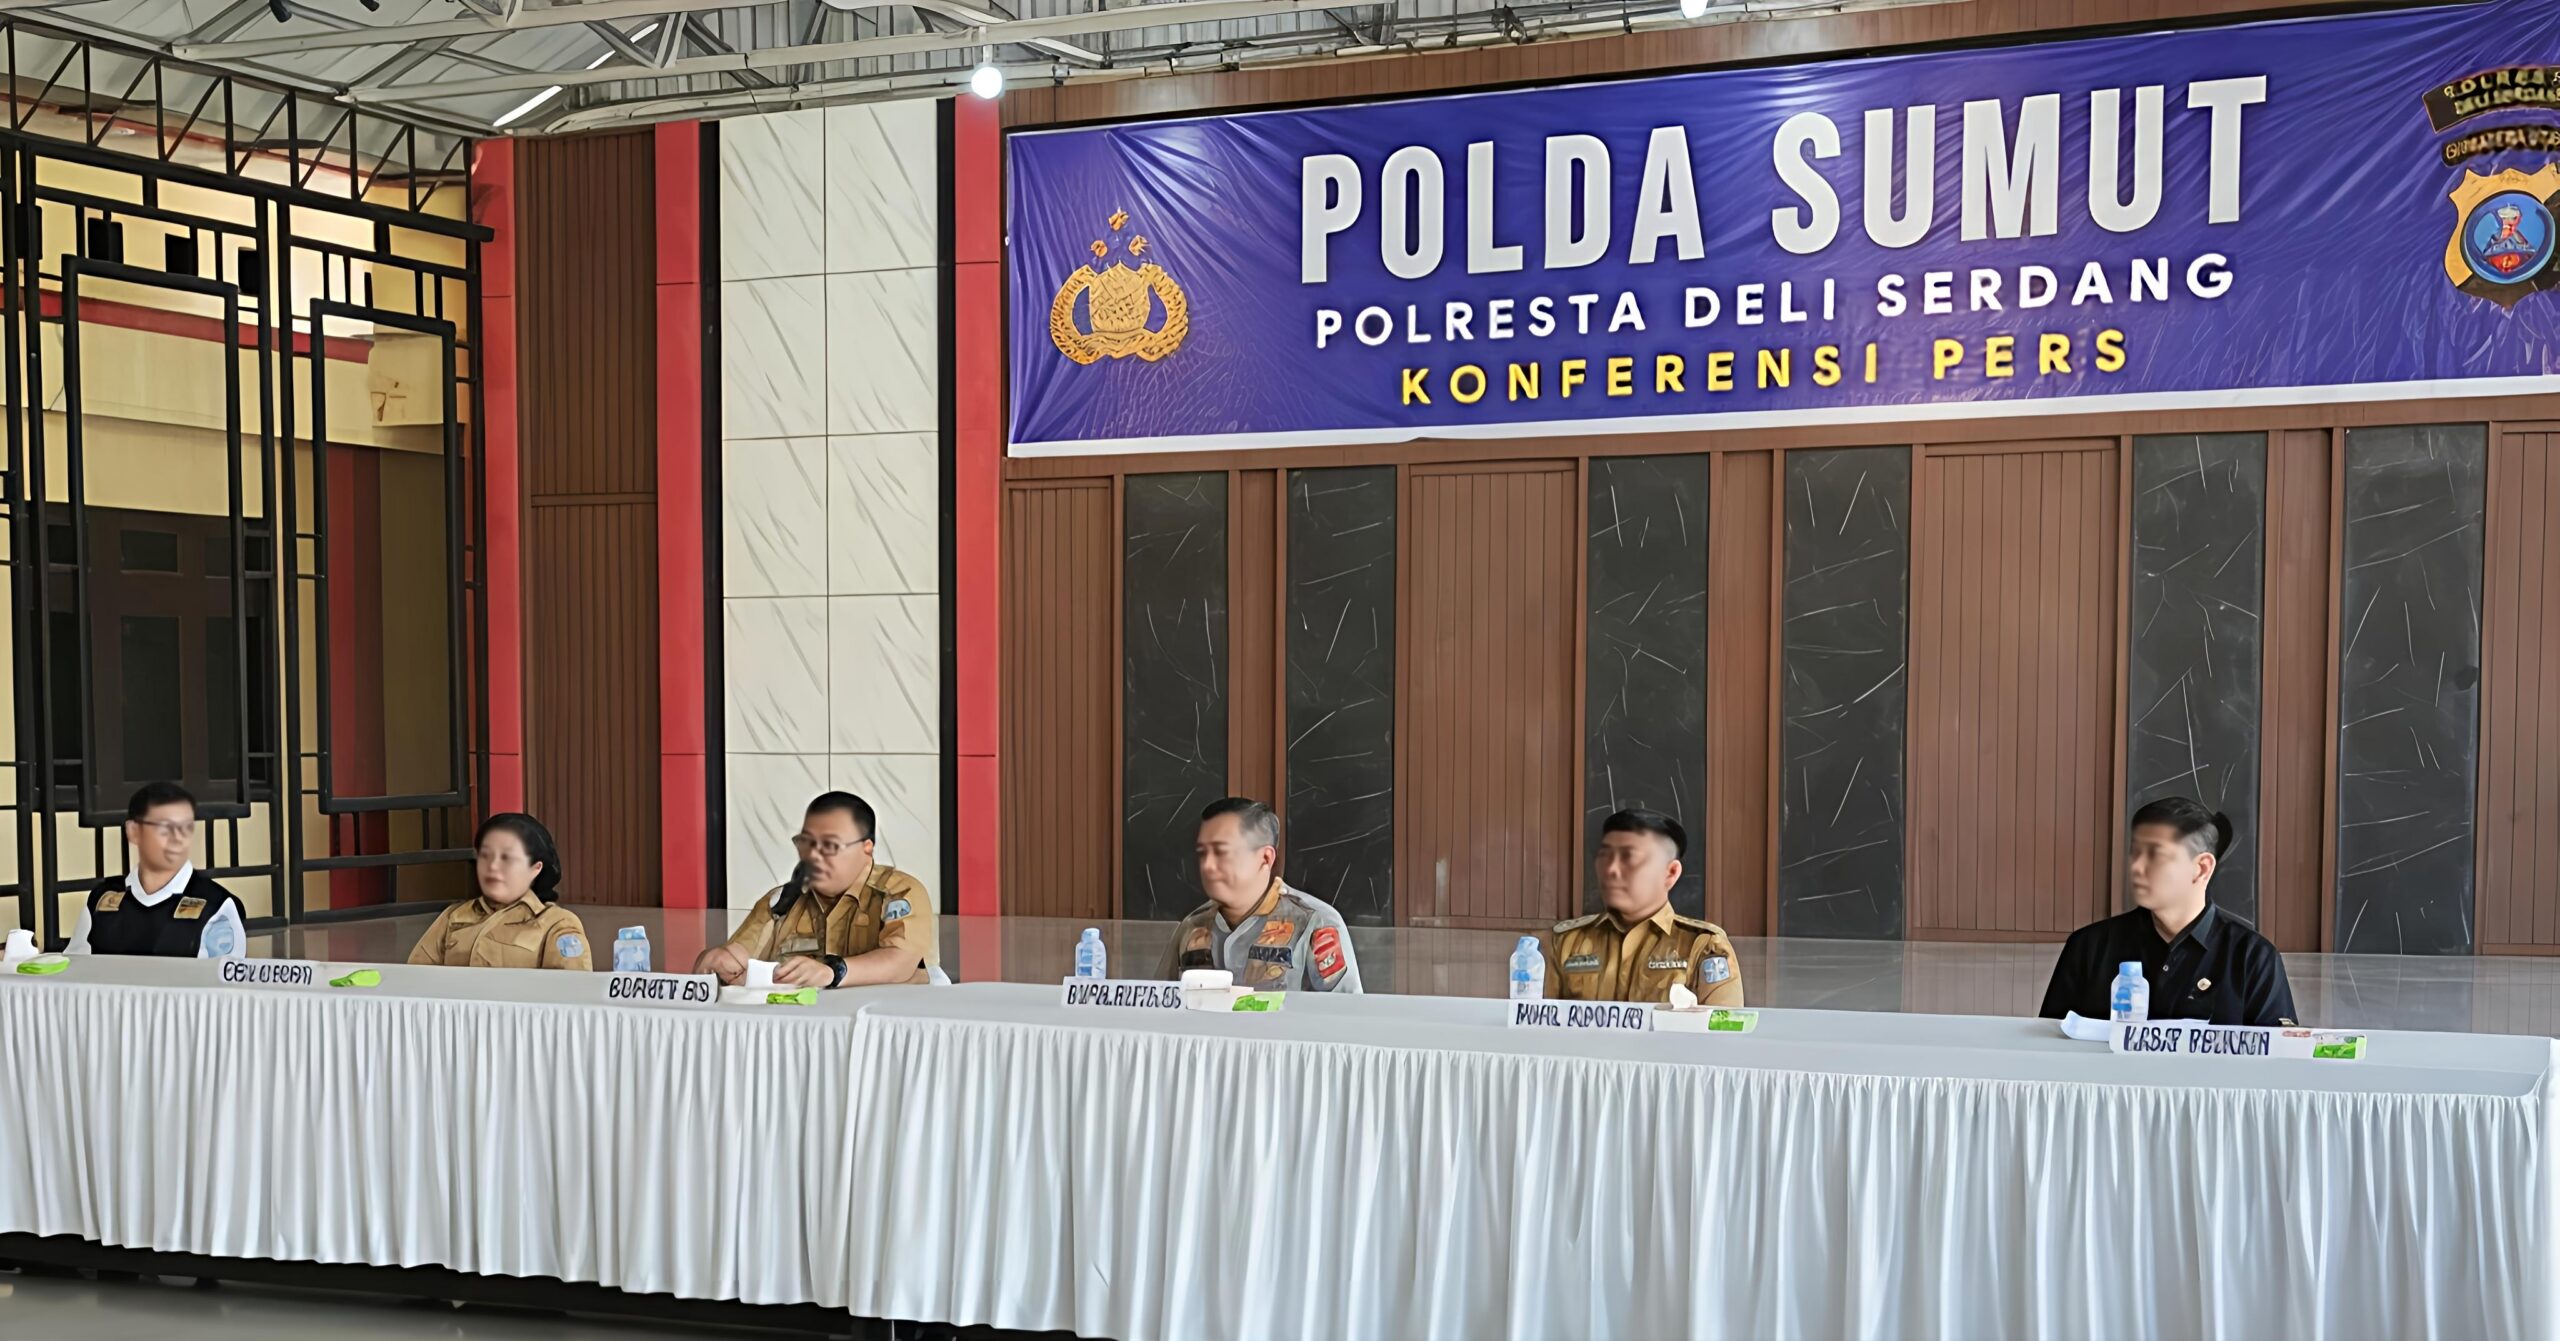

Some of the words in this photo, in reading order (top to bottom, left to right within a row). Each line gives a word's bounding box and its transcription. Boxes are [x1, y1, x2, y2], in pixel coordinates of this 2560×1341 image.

[1301, 125, 1706, 285] POLDA
[1770, 75, 2268, 255] SUMUT
[1315, 291, 1647, 350] POLRESTA
[1684, 278, 1836, 329] DELI
[1875, 252, 2235, 319] SERDANG
[1401, 343, 1878, 406] KONFERENSI
[1932, 328, 2127, 380] PERS
